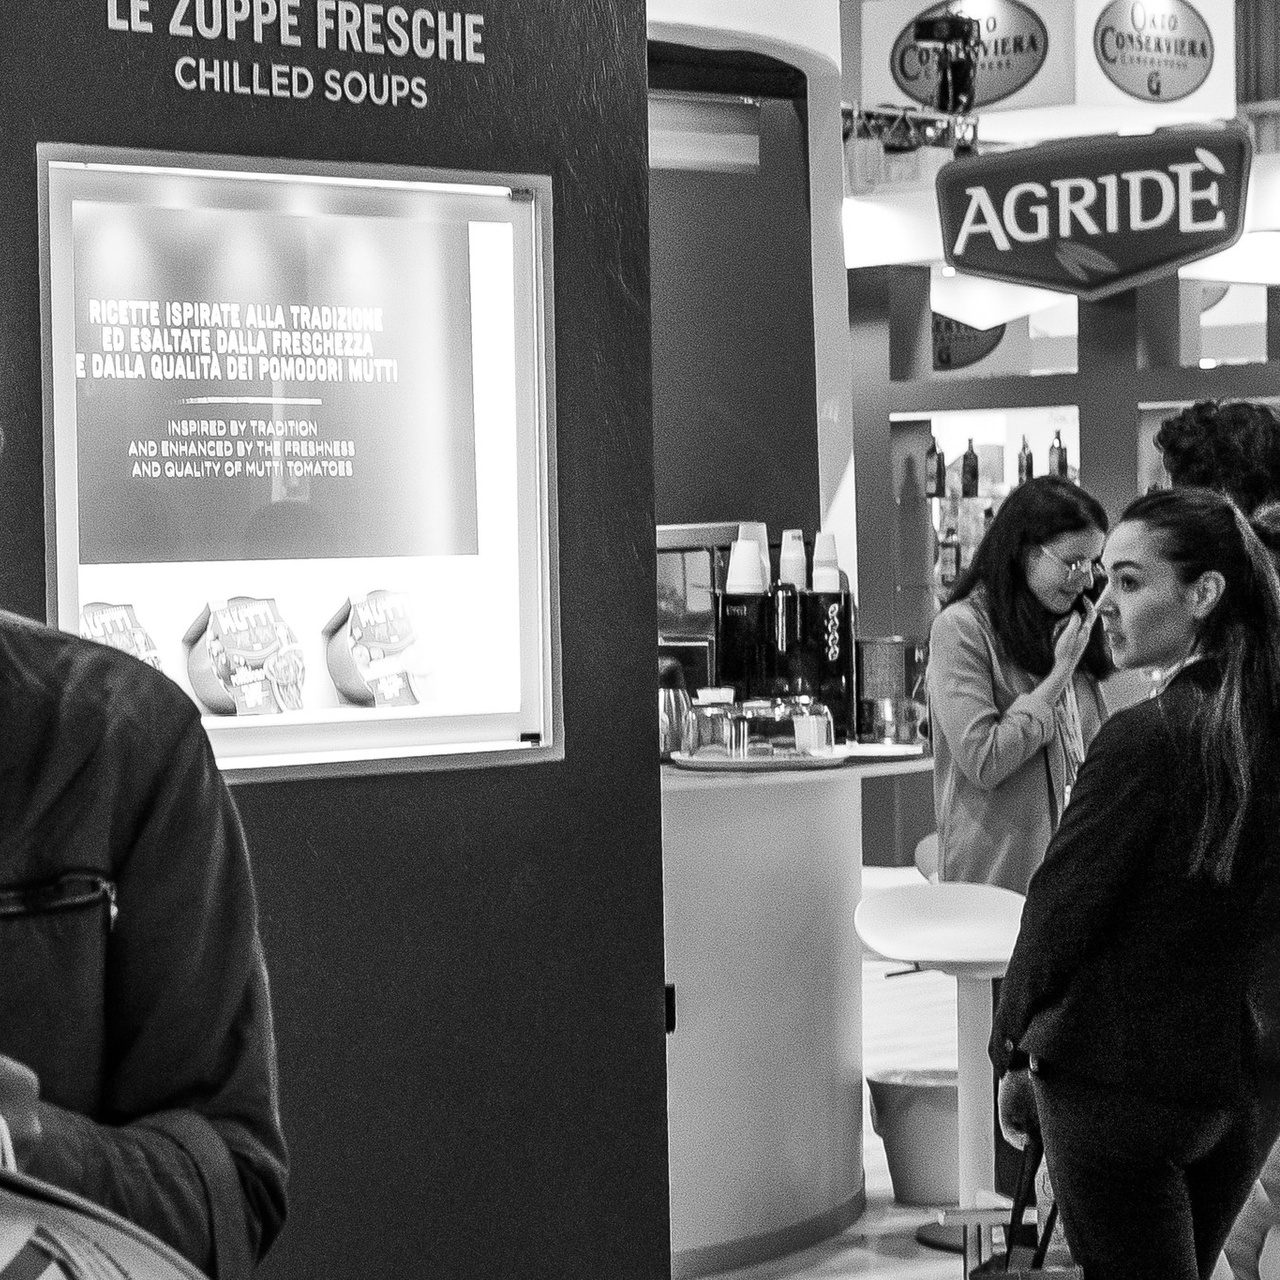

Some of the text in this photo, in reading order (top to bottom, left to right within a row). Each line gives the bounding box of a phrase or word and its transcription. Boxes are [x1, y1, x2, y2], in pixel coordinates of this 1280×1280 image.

[1099, 25, 1209, 65] CONSERVIERA
[175, 57, 429, 108] CHILLED SOUPS
[952, 148, 1227, 256] AGRIDÈ
[89, 299, 384, 332] RICETTE ISPIRATE ALLA TRADIZIONE
[102, 326, 374, 357] ED ESALTATE DALLA FRESCHEZZA
[75, 350, 399, 384] E DALLA QUALITÀ DEI POMODORI MUTTI
[168, 419, 318, 437] INSPIRED BY TRADITION
[128, 440, 356, 458] AND ENHANCED BY THE FRESHNESS
[132, 461, 354, 478] AND QUALITY OF MUTTI TOMATOES
[217, 602, 276, 636] MUTTI
